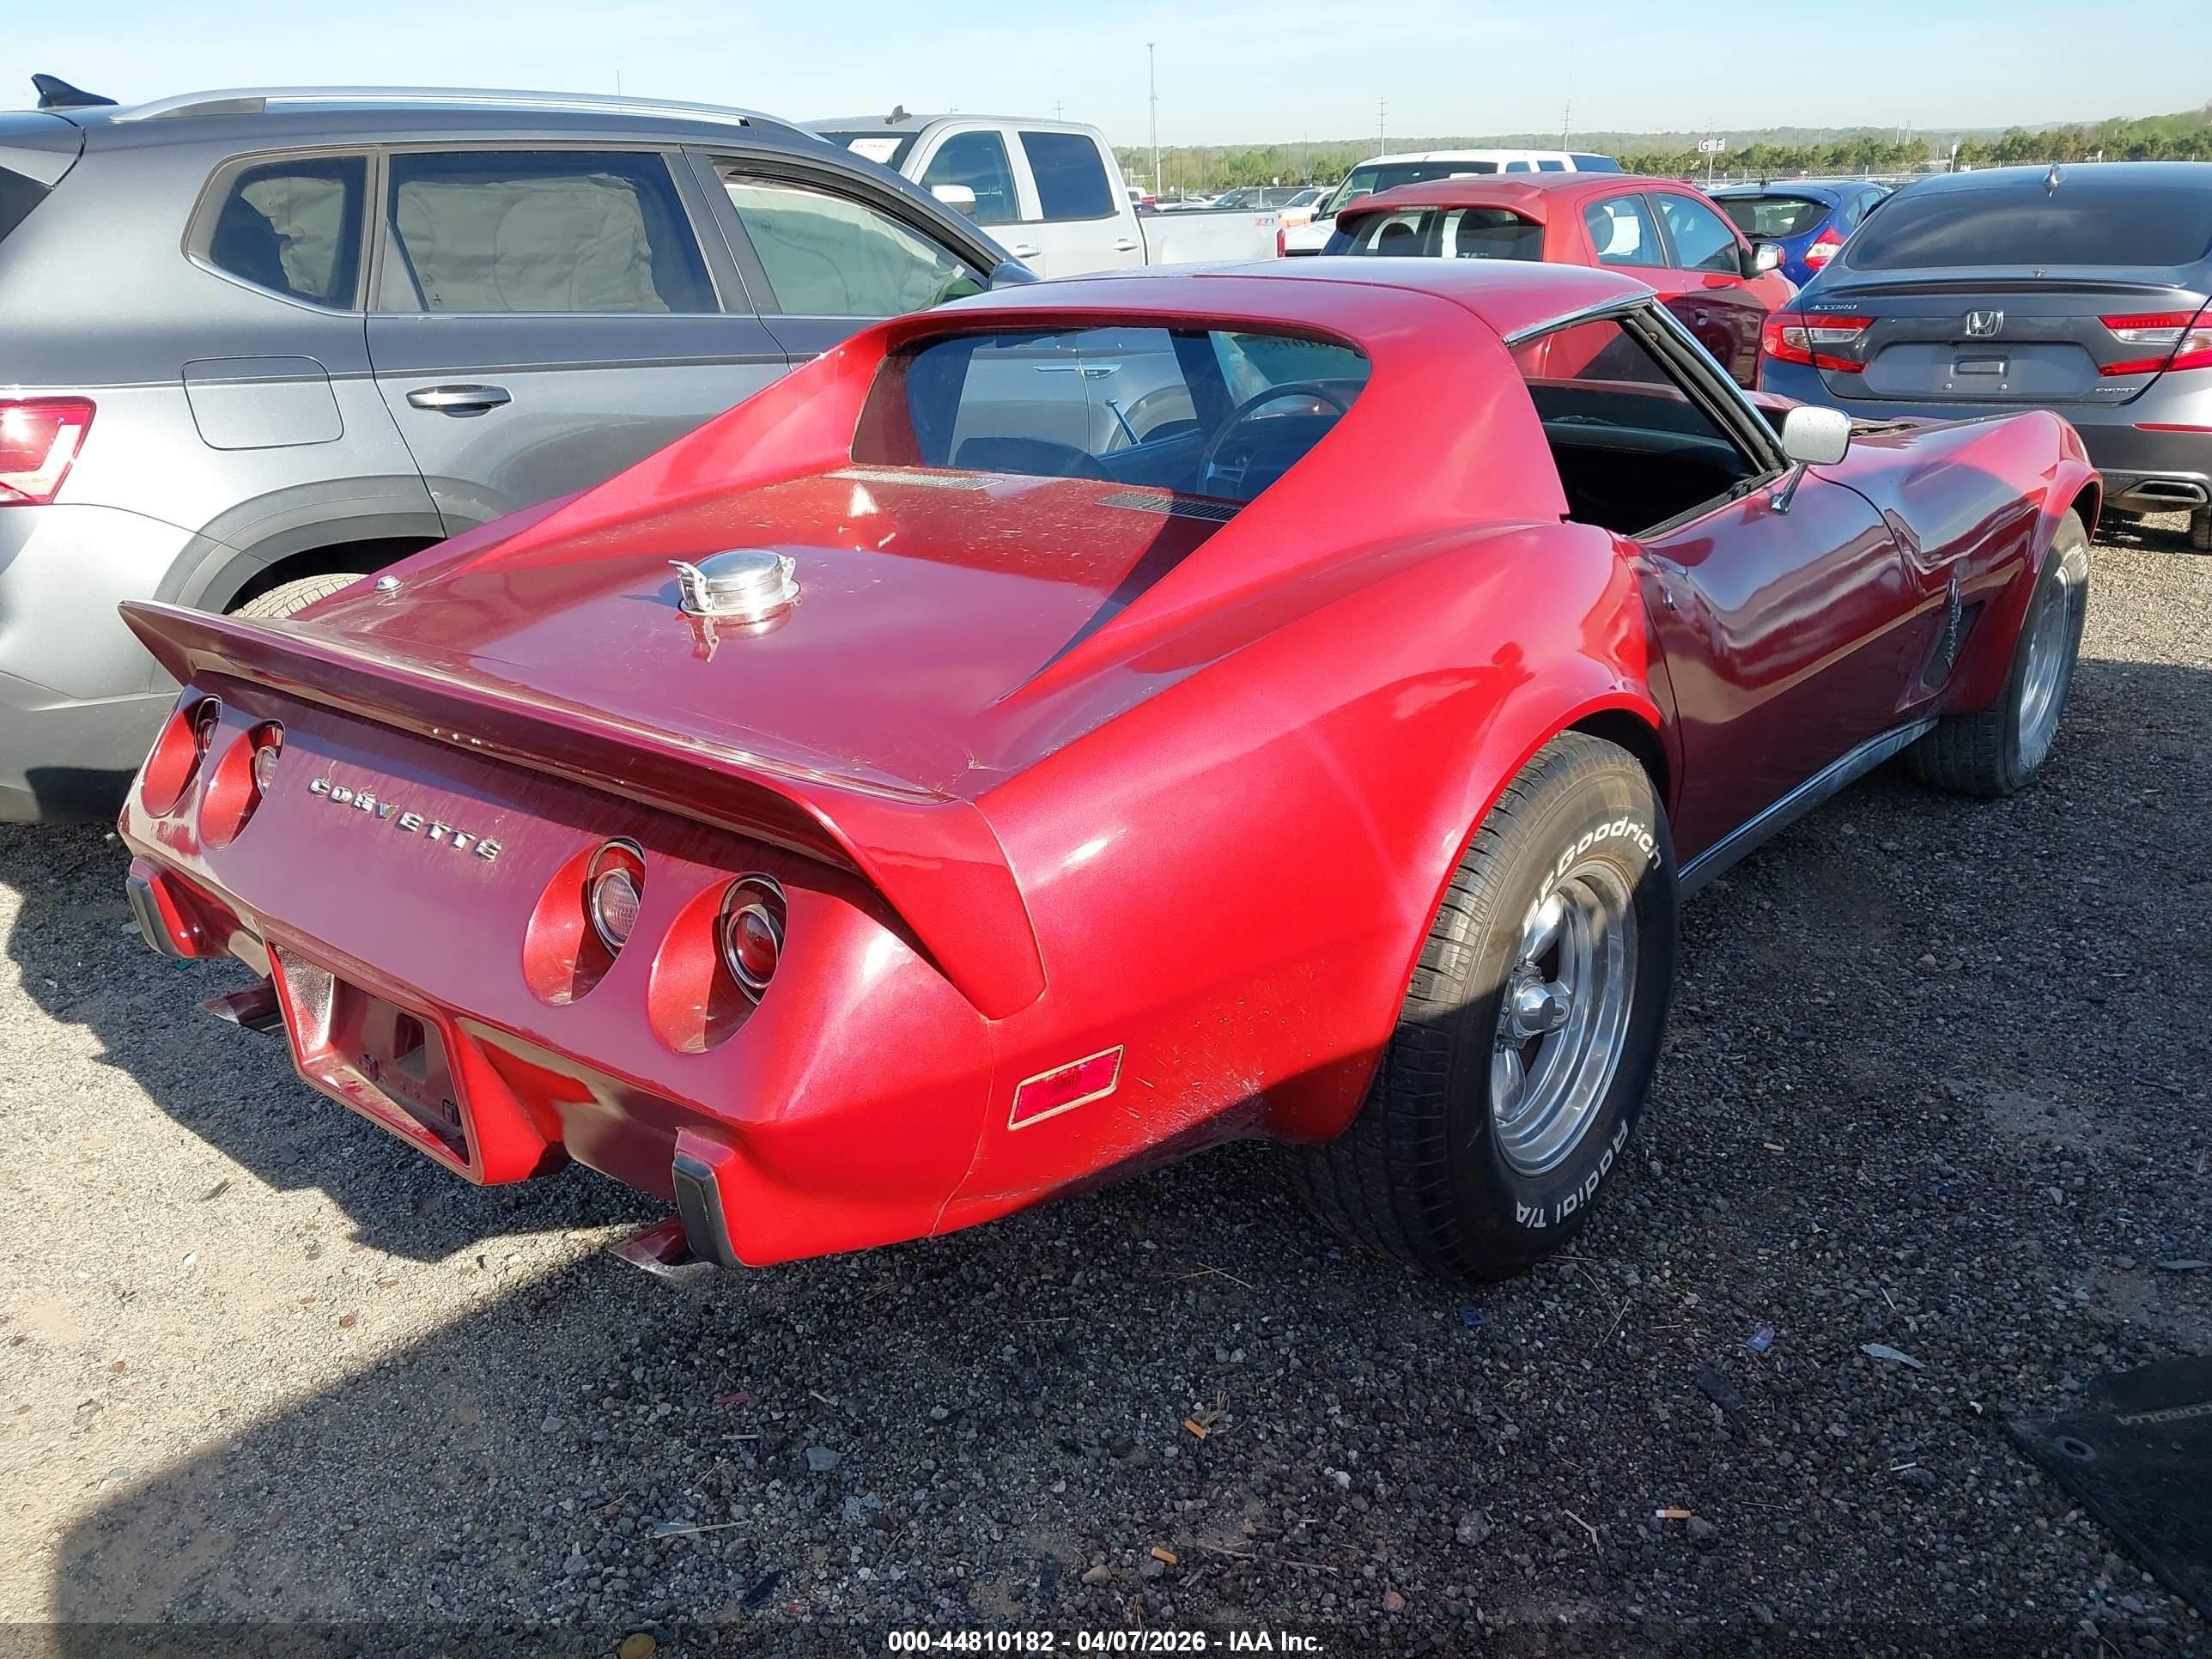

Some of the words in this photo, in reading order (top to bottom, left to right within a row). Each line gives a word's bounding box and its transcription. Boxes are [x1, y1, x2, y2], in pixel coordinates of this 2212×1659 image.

[1700, 139, 1709, 151] G
[310, 778, 502, 861] CORVETTE
[1556, 1119, 1628, 1224] Radial
[1516, 1201, 1547, 1228] T/A
